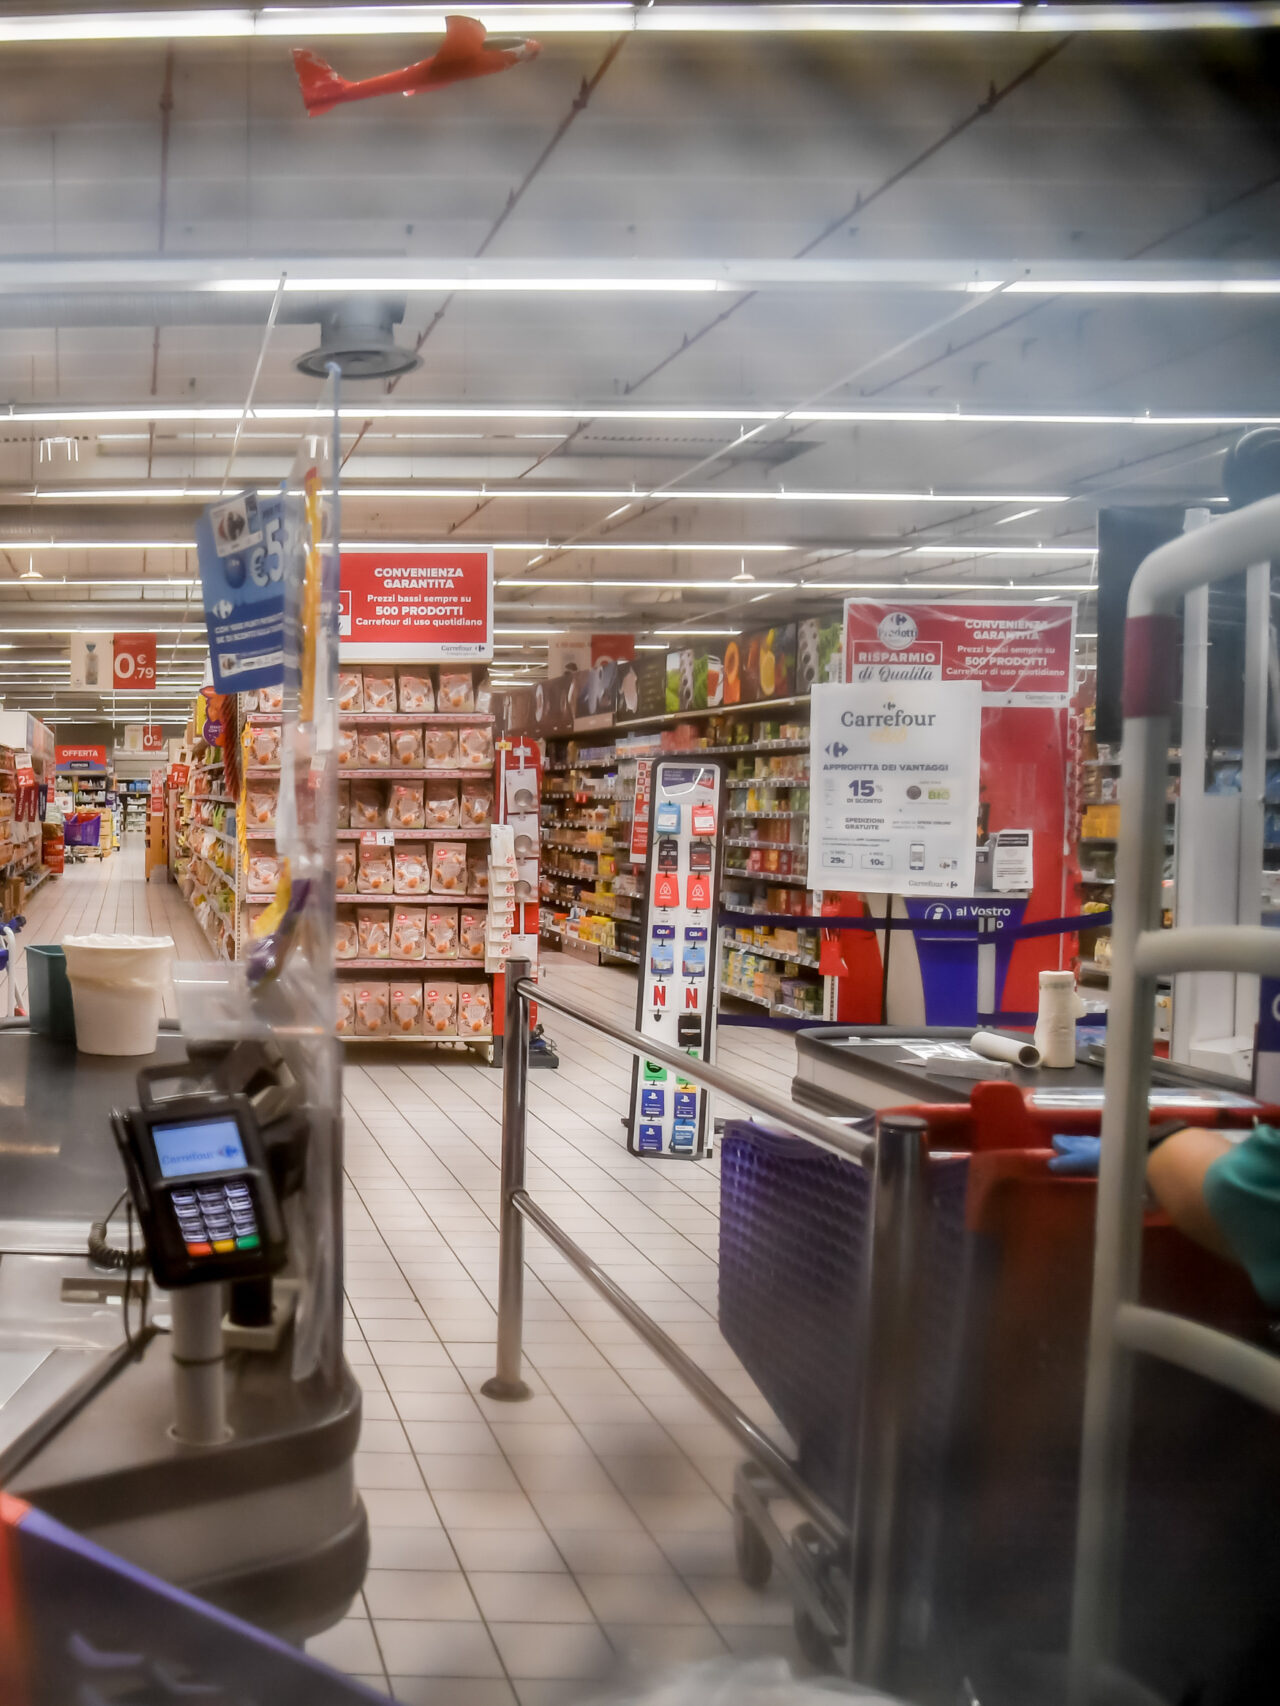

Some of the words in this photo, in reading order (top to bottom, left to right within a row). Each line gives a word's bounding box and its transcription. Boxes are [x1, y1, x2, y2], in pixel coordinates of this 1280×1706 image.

[374, 568, 464, 578] CONVENIENZA
[383, 579, 455, 589] GARANTITA
[367, 594, 396, 603] Prezzi
[397, 594, 422, 603] bassi
[423, 595, 459, 605] sempre
[375, 606, 399, 616] 500
[401, 606, 464, 616] PRODOTTI
[355, 617, 401, 626] Carrefour
[402, 617, 412, 626] di
[432, 617, 483, 628] quotidiano
[964, 620, 1049, 630] CONVENIENZA
[957, 645, 984, 654] Prezzi
[1010, 647, 1044, 655] sempre
[858, 652, 936, 663] RISPARMIO
[965, 657, 987, 666] 500
[989, 657, 1048, 667] PRODOTTI
[858, 666, 873, 682] di
[946, 667, 989, 676] Carrefour
[990, 668, 999, 676] di
[1018, 668, 1065, 678] quotidiano
[840, 710, 937, 728] Carrefour
[62, 750, 99, 758] OFFERTA
[823, 764, 879, 772] APPROFITTA
[881, 764, 897, 772] DEI
[899, 764, 949, 772] VANTAGGI
[848, 779, 875, 797] 15
[927, 789, 951, 800] BIO
[955, 906, 967, 916] al
[970, 906, 1011, 917] Vostro
[653, 985, 666, 1007] N
[685, 987, 698, 1009] N
[161, 1150, 215, 1165] Carrefour
